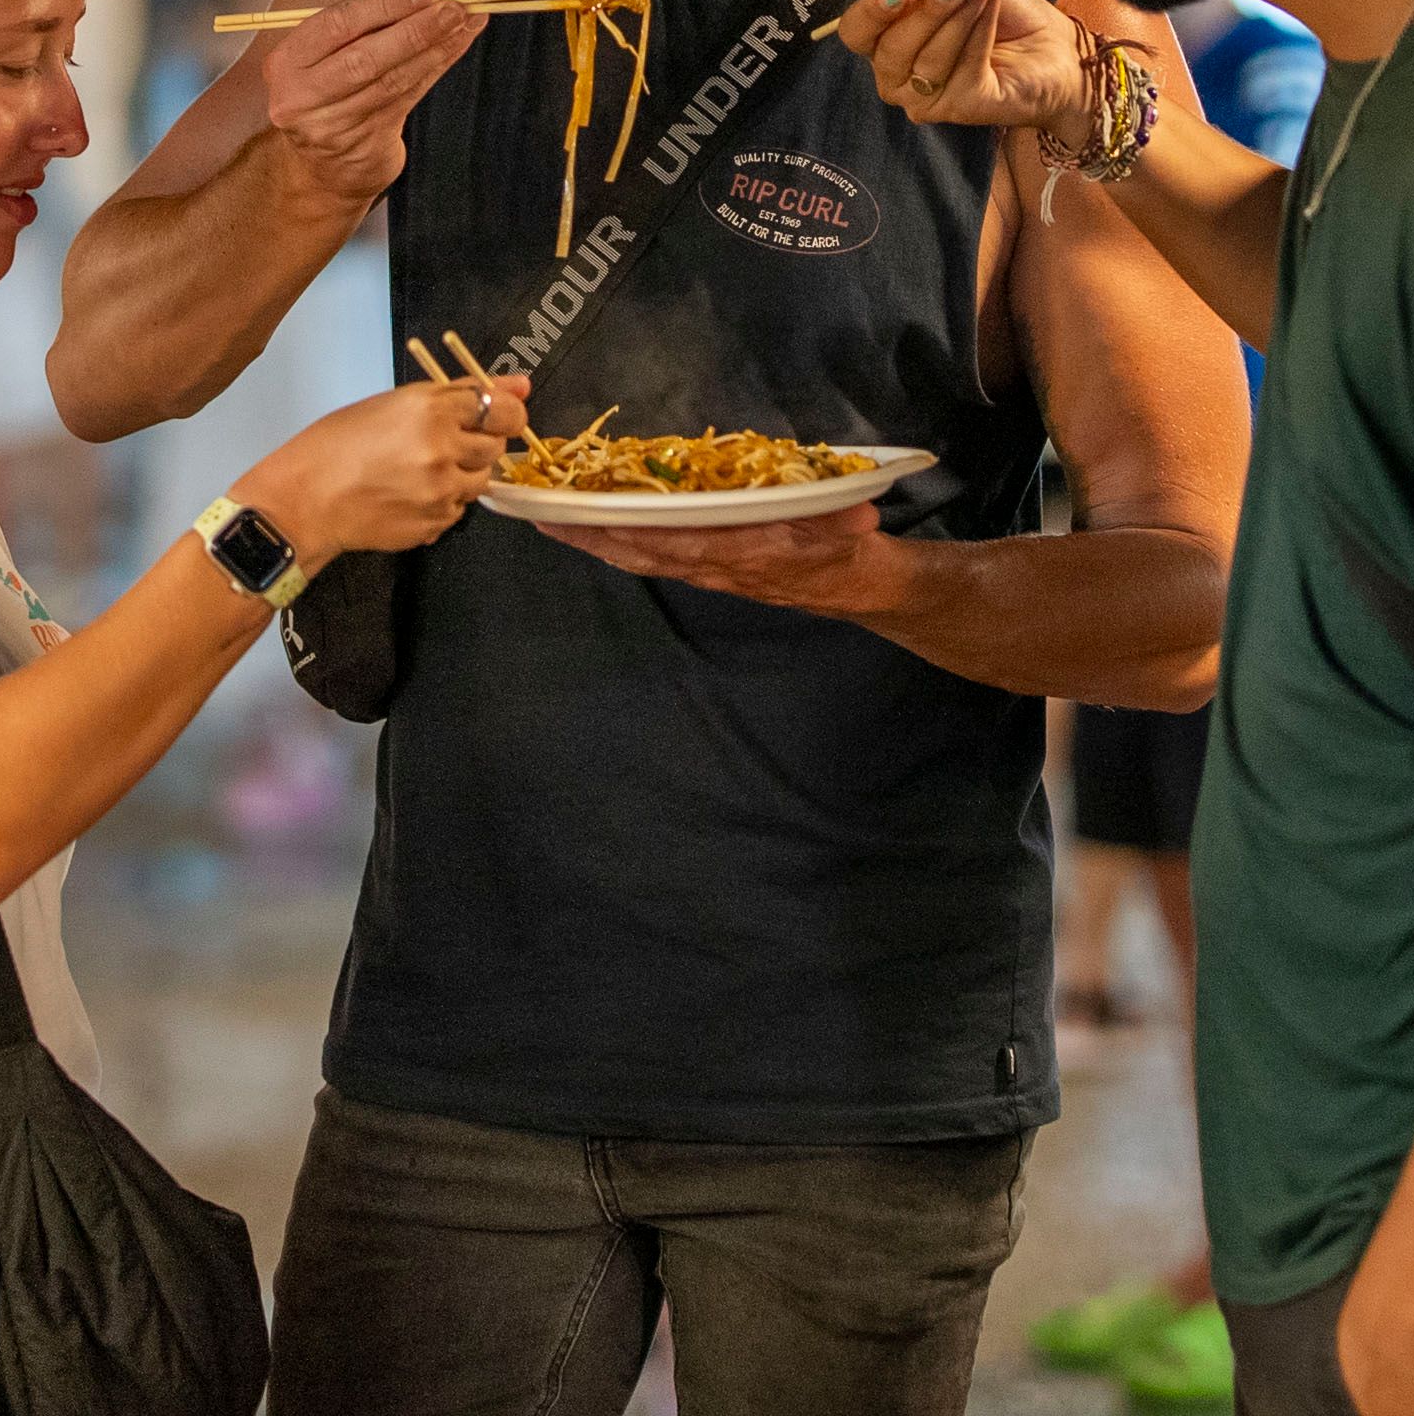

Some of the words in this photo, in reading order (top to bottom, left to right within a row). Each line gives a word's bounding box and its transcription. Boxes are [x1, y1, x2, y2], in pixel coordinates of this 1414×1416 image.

[487, 215, 638, 378] RMOUR
[641, 15, 795, 185] UNDER
[733, 151, 781, 166] QUALITY
[783, 154, 811, 168] SURF
[811, 163, 858, 198] PRODUCTS
[716, 203, 748, 229] BUILT
[747, 222, 770, 240] FOR
[773, 230, 794, 246] THE
[797, 235, 840, 249] SEARCH
[729, 173, 778, 204] RIP
[778, 187, 850, 229] CURL
